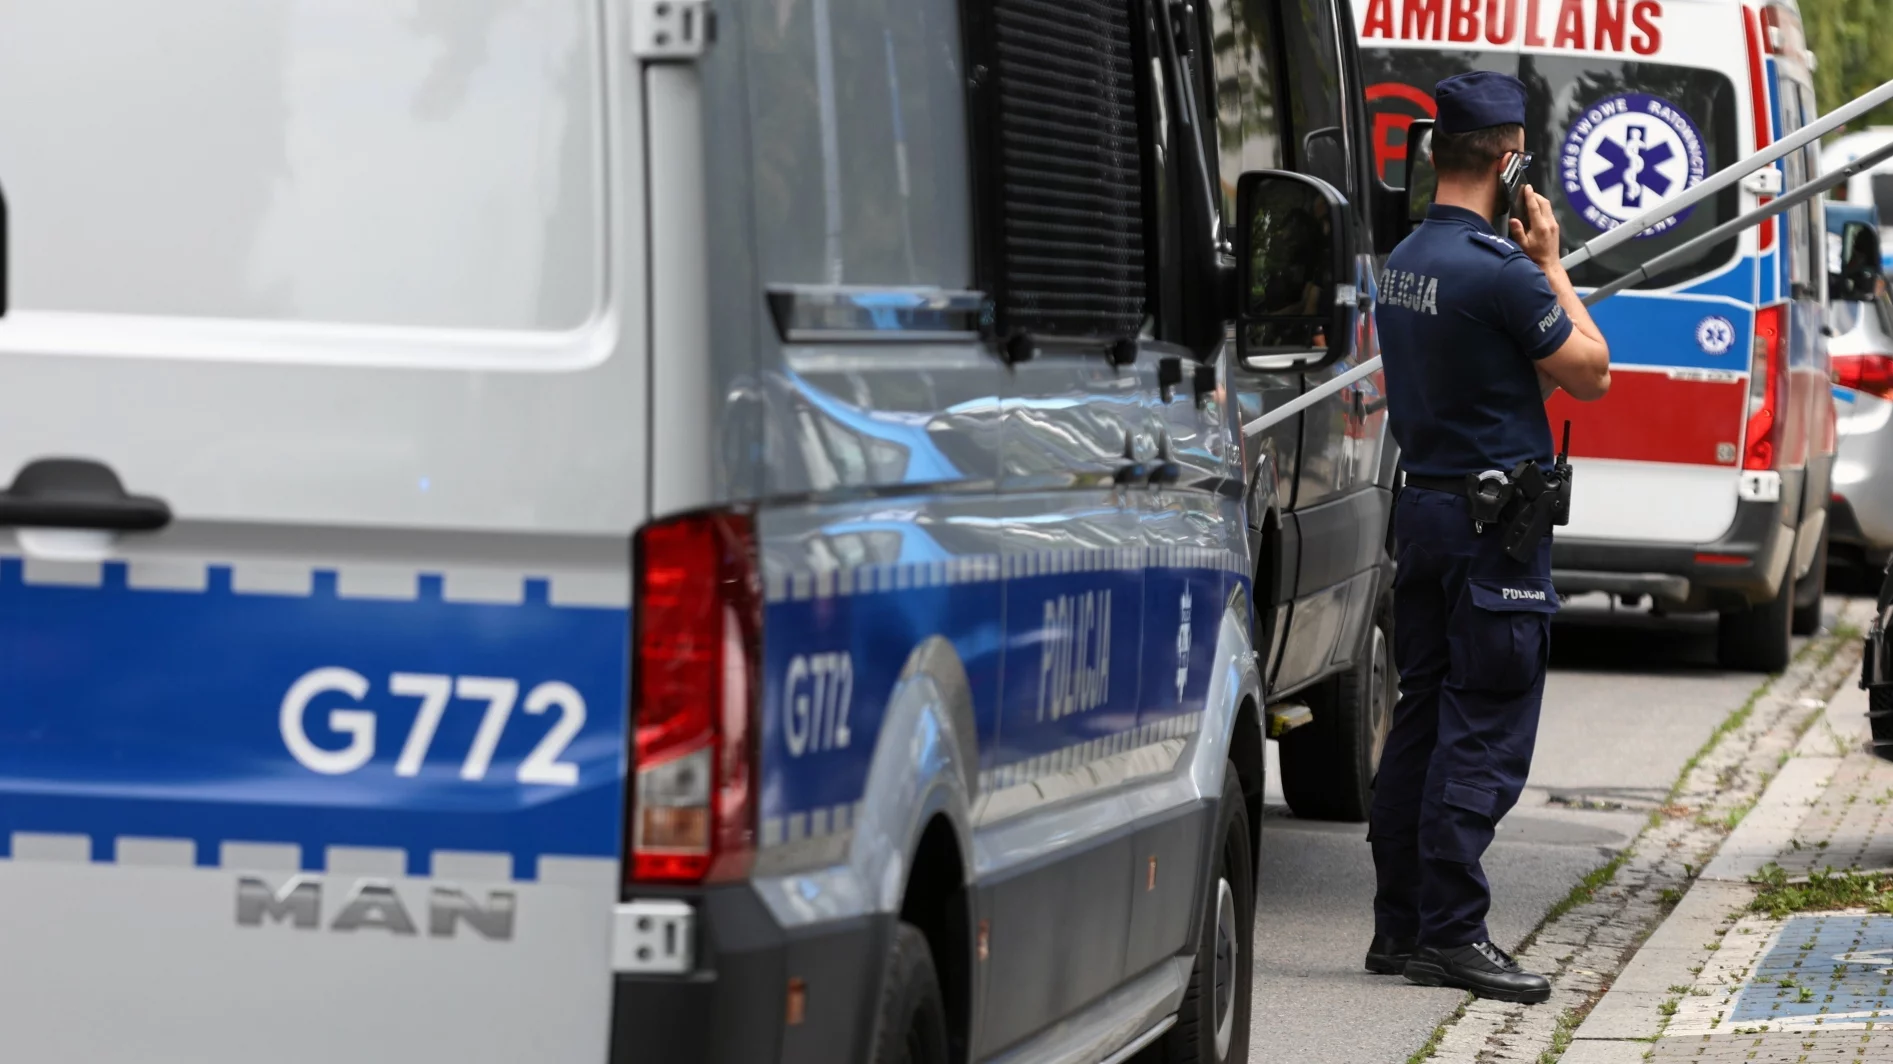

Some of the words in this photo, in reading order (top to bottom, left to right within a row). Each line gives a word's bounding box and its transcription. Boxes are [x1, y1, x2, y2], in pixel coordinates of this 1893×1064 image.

[1361, 0, 1663, 55] AMBULANS
[1647, 99, 1704, 188] RATOWNICTW
[1377, 268, 1439, 315] OLICJA
[1502, 587, 1546, 601] POLICJA
[1035, 589, 1112, 722] POLICJA
[279, 665, 588, 786] G772
[783, 650, 855, 757] G772
[234, 872, 517, 942] MAN
